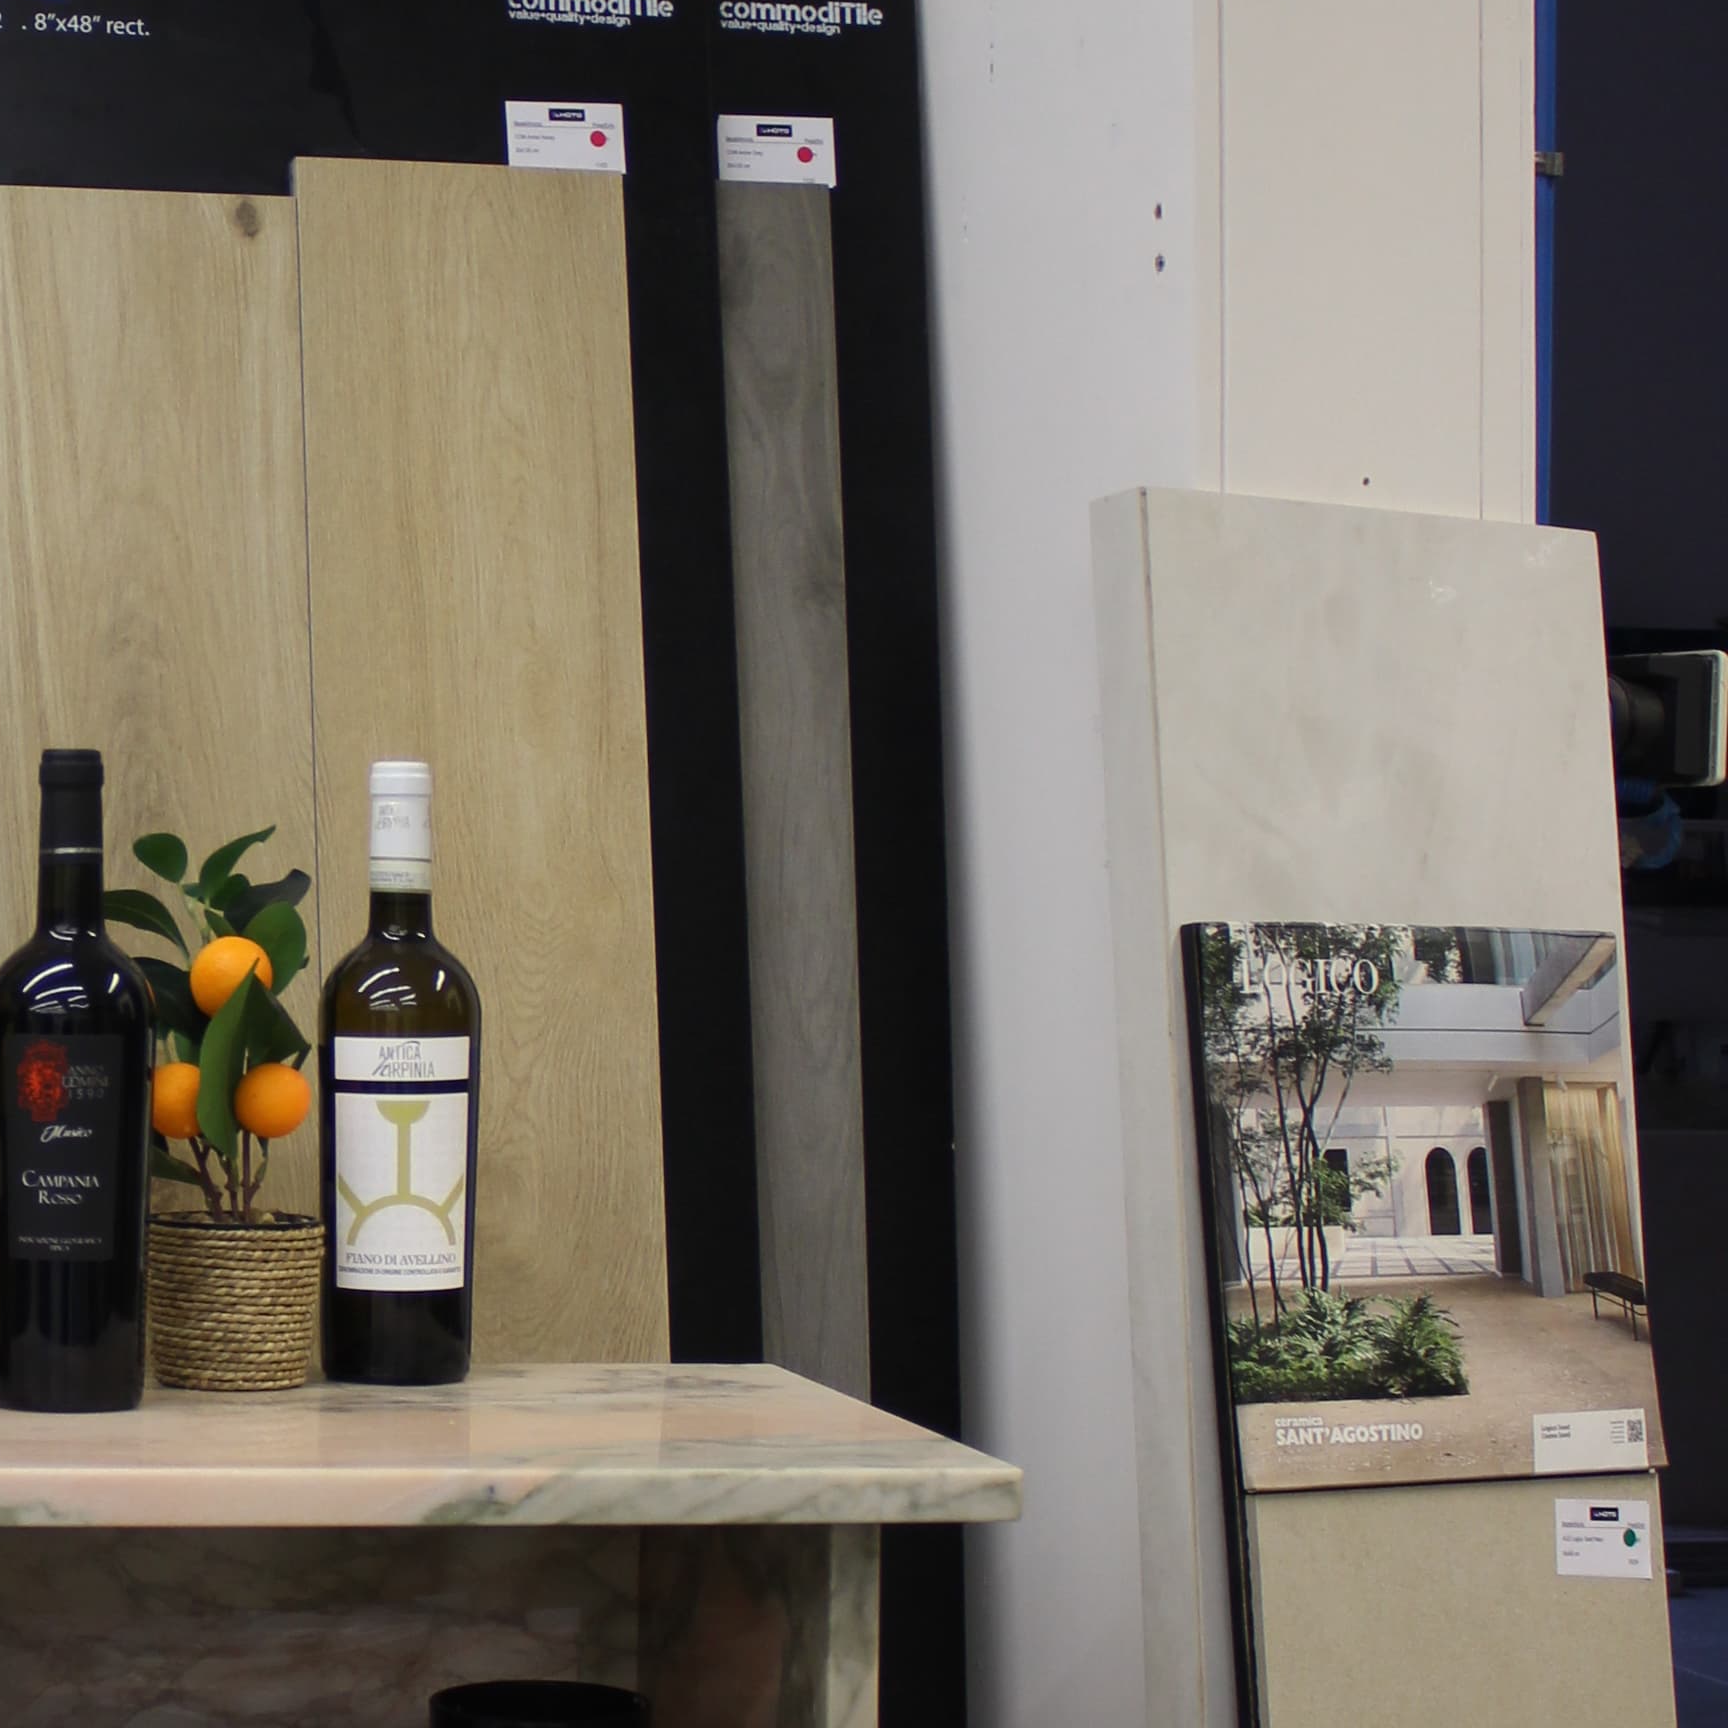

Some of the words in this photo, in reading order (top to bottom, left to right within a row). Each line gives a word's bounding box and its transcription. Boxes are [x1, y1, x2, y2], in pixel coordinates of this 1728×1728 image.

[719, 1, 884, 26] commodiTile
[106, 19, 151, 37] rect.
[1239, 958, 1380, 994] LOGICO
[345, 1252, 383, 1265] FIANO
[384, 1254, 398, 1265] DI
[400, 1253, 457, 1266] AVELLINO
[1274, 1416, 1323, 1428] ceramica
[1276, 1423, 1423, 1446] SANT'AGOSTINO
